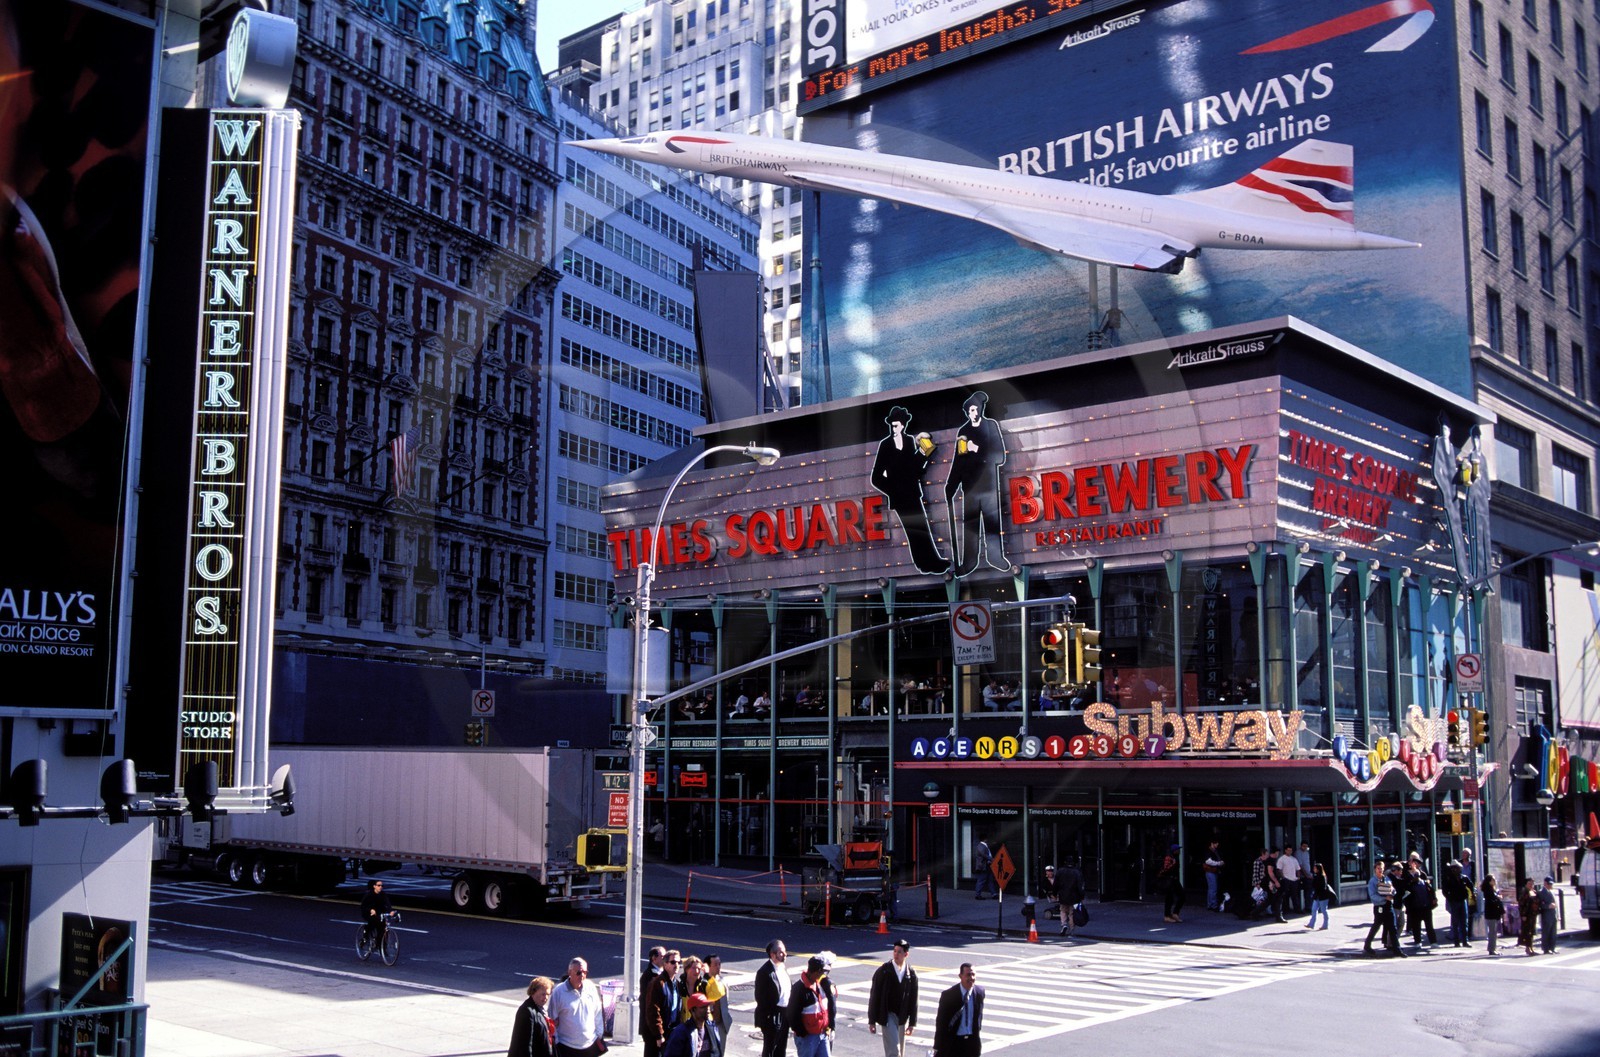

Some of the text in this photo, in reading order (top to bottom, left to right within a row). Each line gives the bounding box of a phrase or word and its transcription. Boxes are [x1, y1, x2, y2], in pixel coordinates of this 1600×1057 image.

[882, 9, 908, 26] YOUR
[910, 0, 939, 16] JOKES
[819, 66, 859, 96] For
[868, 42, 928, 78] more
[940, 7, 1025, 52] laughs,
[998, 62, 1335, 175] BRITISH AIRWAYS
[1127, 134, 1238, 180] favourite
[1246, 114, 1331, 150] airline
[1218, 230, 1265, 245] G-BOAA
[193, 119, 262, 635] WARNER BROS.
[1289, 429, 1419, 504] TIMES SQUARE
[608, 445, 1255, 571] TIMES SQUARE BREWERY
[1313, 477, 1392, 528] BREWERY
[1035, 518, 1164, 546] RESTAURANT
[30, 623, 81, 642] place
[20, 644, 58, 655] CASINO
[60, 646, 95, 657] RESORT
[180, 711, 236, 723] STUDIO
[183, 726, 232, 739] STORE
[614, 731, 628, 740] ON
[1083, 701, 1304, 761] Subway
[672, 739, 691, 747] BREWERY
[778, 739, 799, 747] BREWERY
[801, 738, 829, 746] RESTAURANT
[913, 738, 1160, 756] A C E N R S 1 2 3 9 7
[605, 775, 611, 788] W
[612, 775, 621, 788] 42
